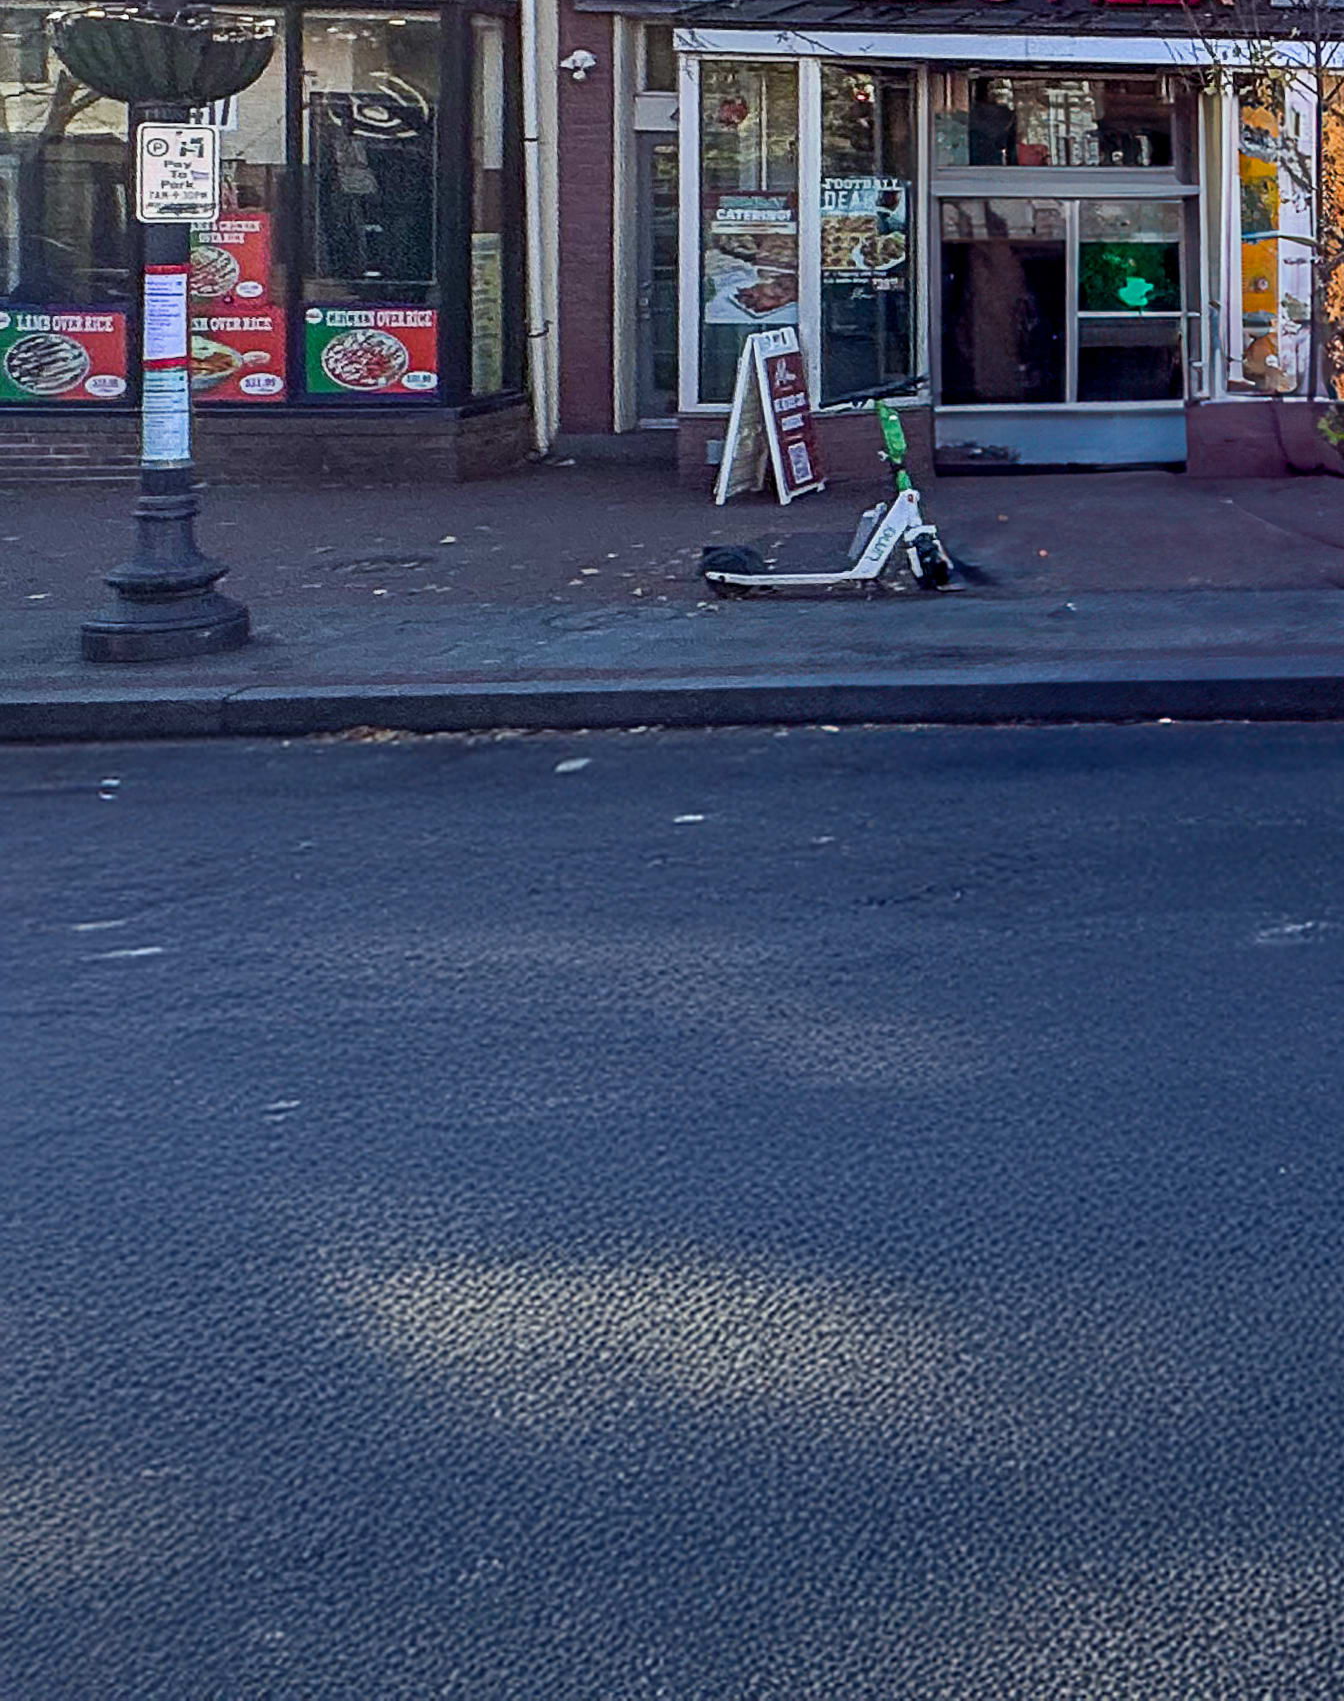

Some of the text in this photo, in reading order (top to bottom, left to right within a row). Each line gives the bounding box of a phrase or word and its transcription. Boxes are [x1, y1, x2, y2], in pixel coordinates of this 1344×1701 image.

[164, 160, 192, 169] Pay
[170, 170, 187, 179] To
[160, 180, 194, 189] Park
